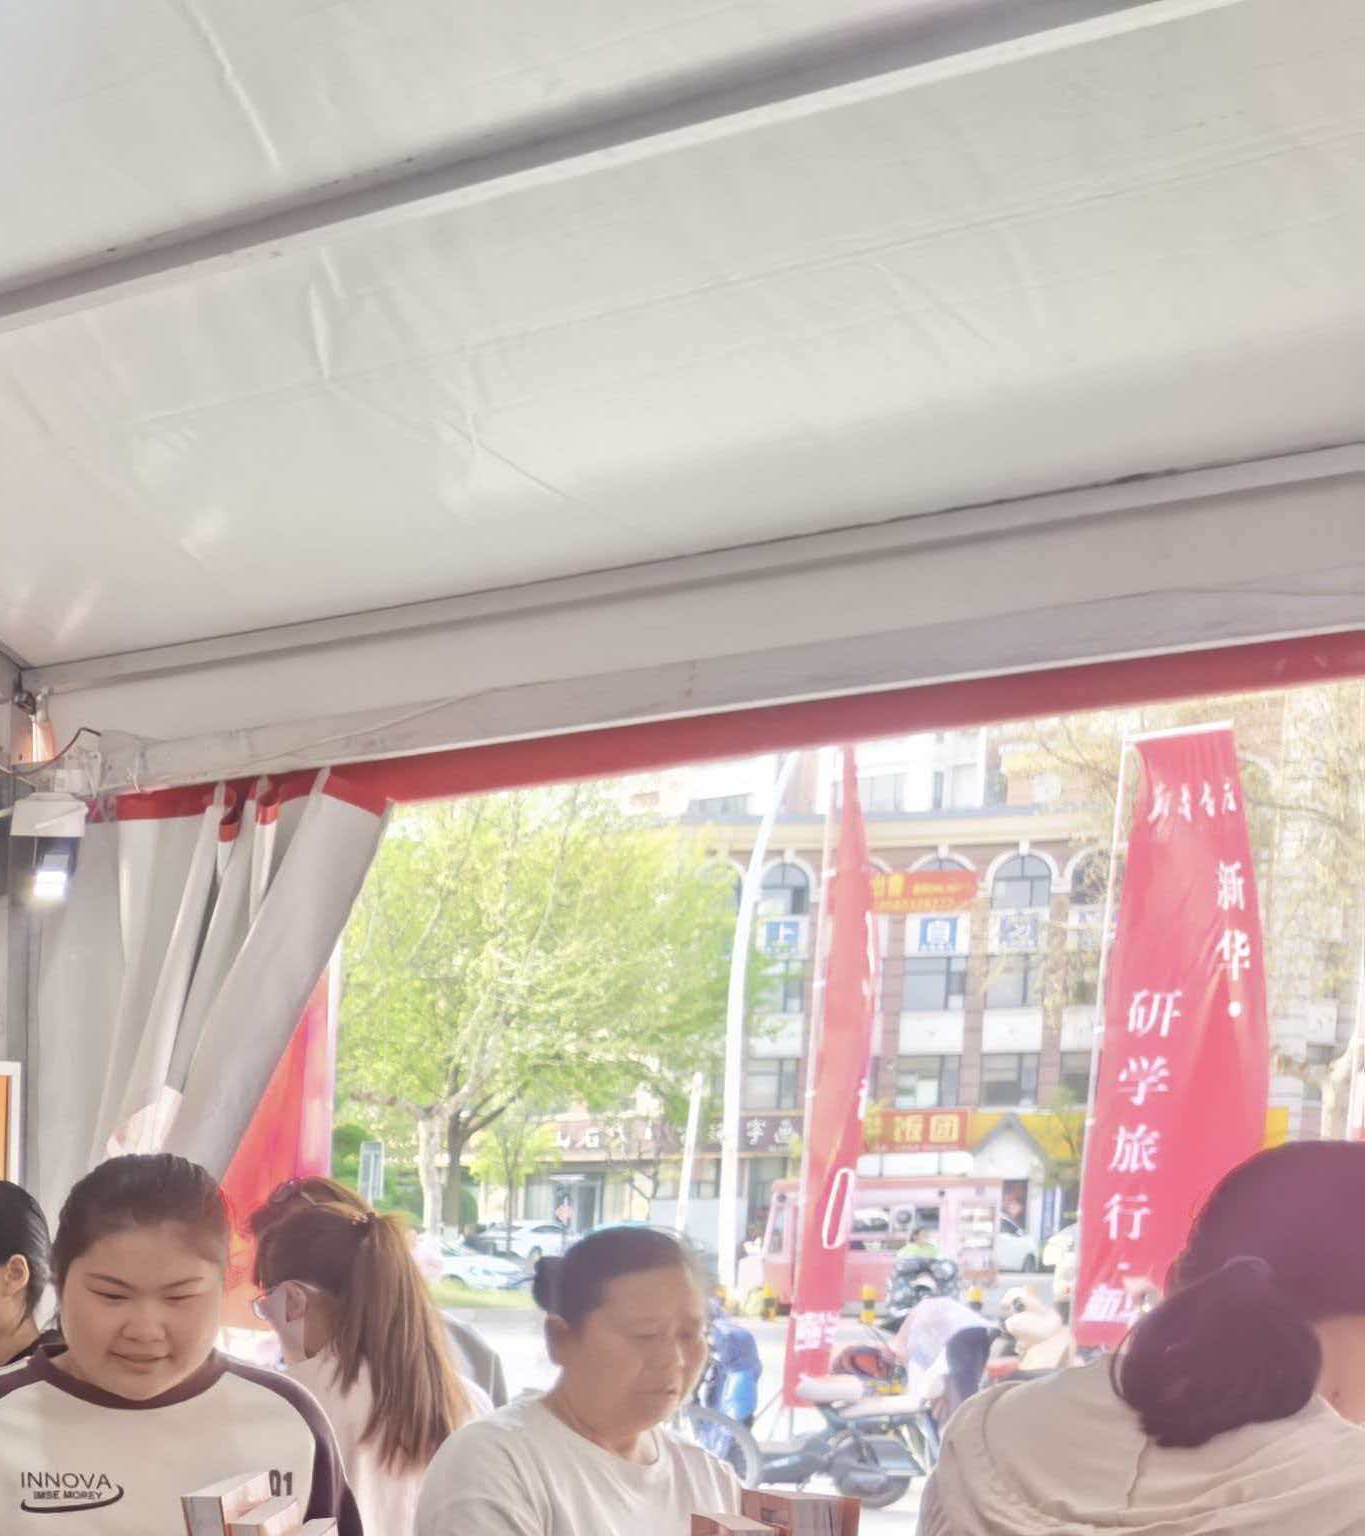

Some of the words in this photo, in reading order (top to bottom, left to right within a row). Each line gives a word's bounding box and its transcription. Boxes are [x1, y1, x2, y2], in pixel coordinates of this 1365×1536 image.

[1103, 987, 1183, 1241] 研学旅行
[20, 1470, 113, 1491] INNOVA
